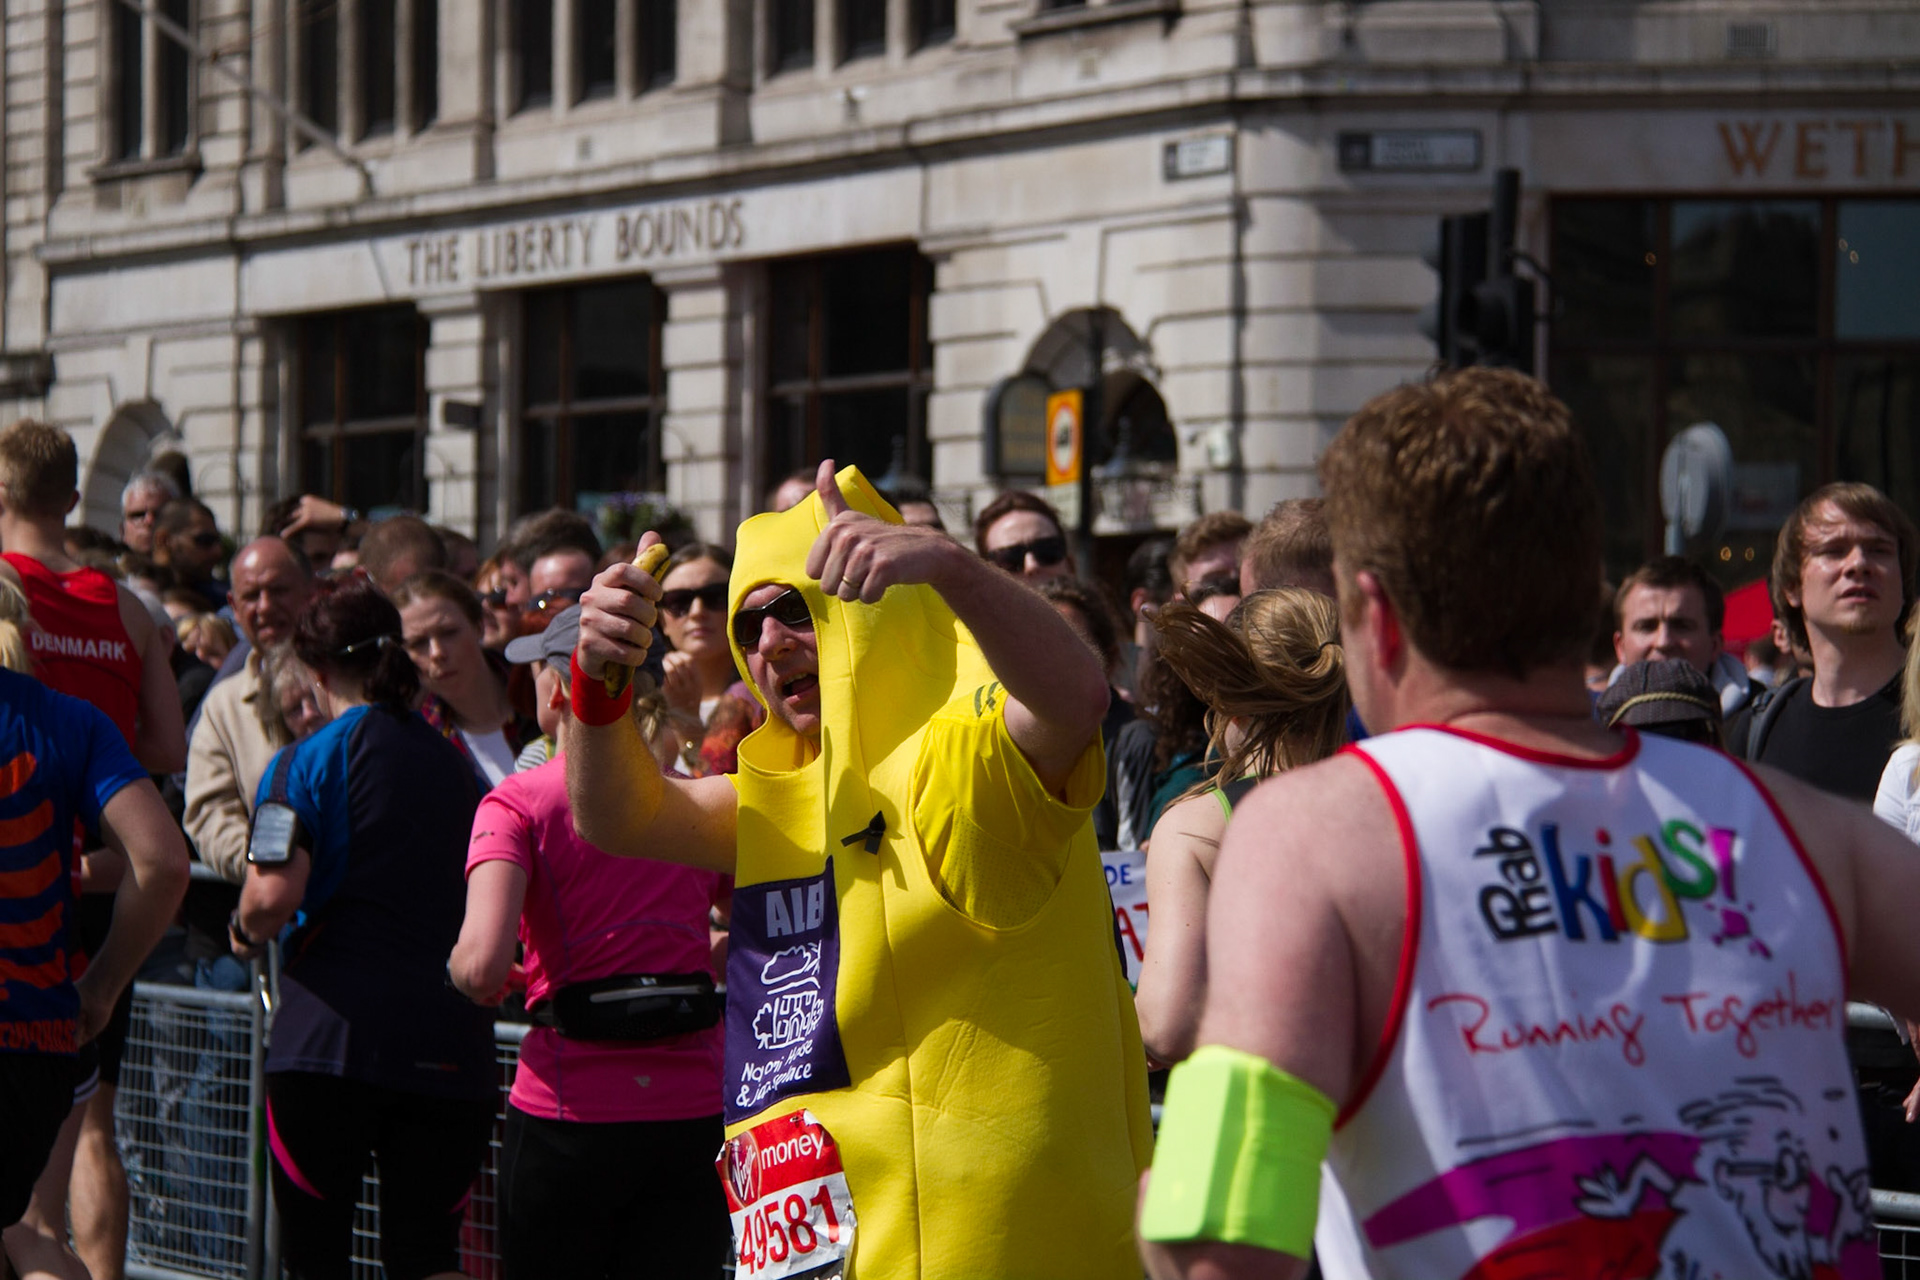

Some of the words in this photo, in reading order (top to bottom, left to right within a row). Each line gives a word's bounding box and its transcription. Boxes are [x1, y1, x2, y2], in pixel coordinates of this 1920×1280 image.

[406, 235, 459, 286] THE
[476, 220, 597, 278] LIBERTY
[615, 200, 744, 262] BOUNDS
[31, 631, 126, 662] DENMARK
[1427, 990, 1645, 1068] Running
[1660, 968, 1837, 1060] Together
[735, 1084, 750, 1107] &
[761, 1129, 825, 1171] money
[740, 1184, 840, 1275] 49581
